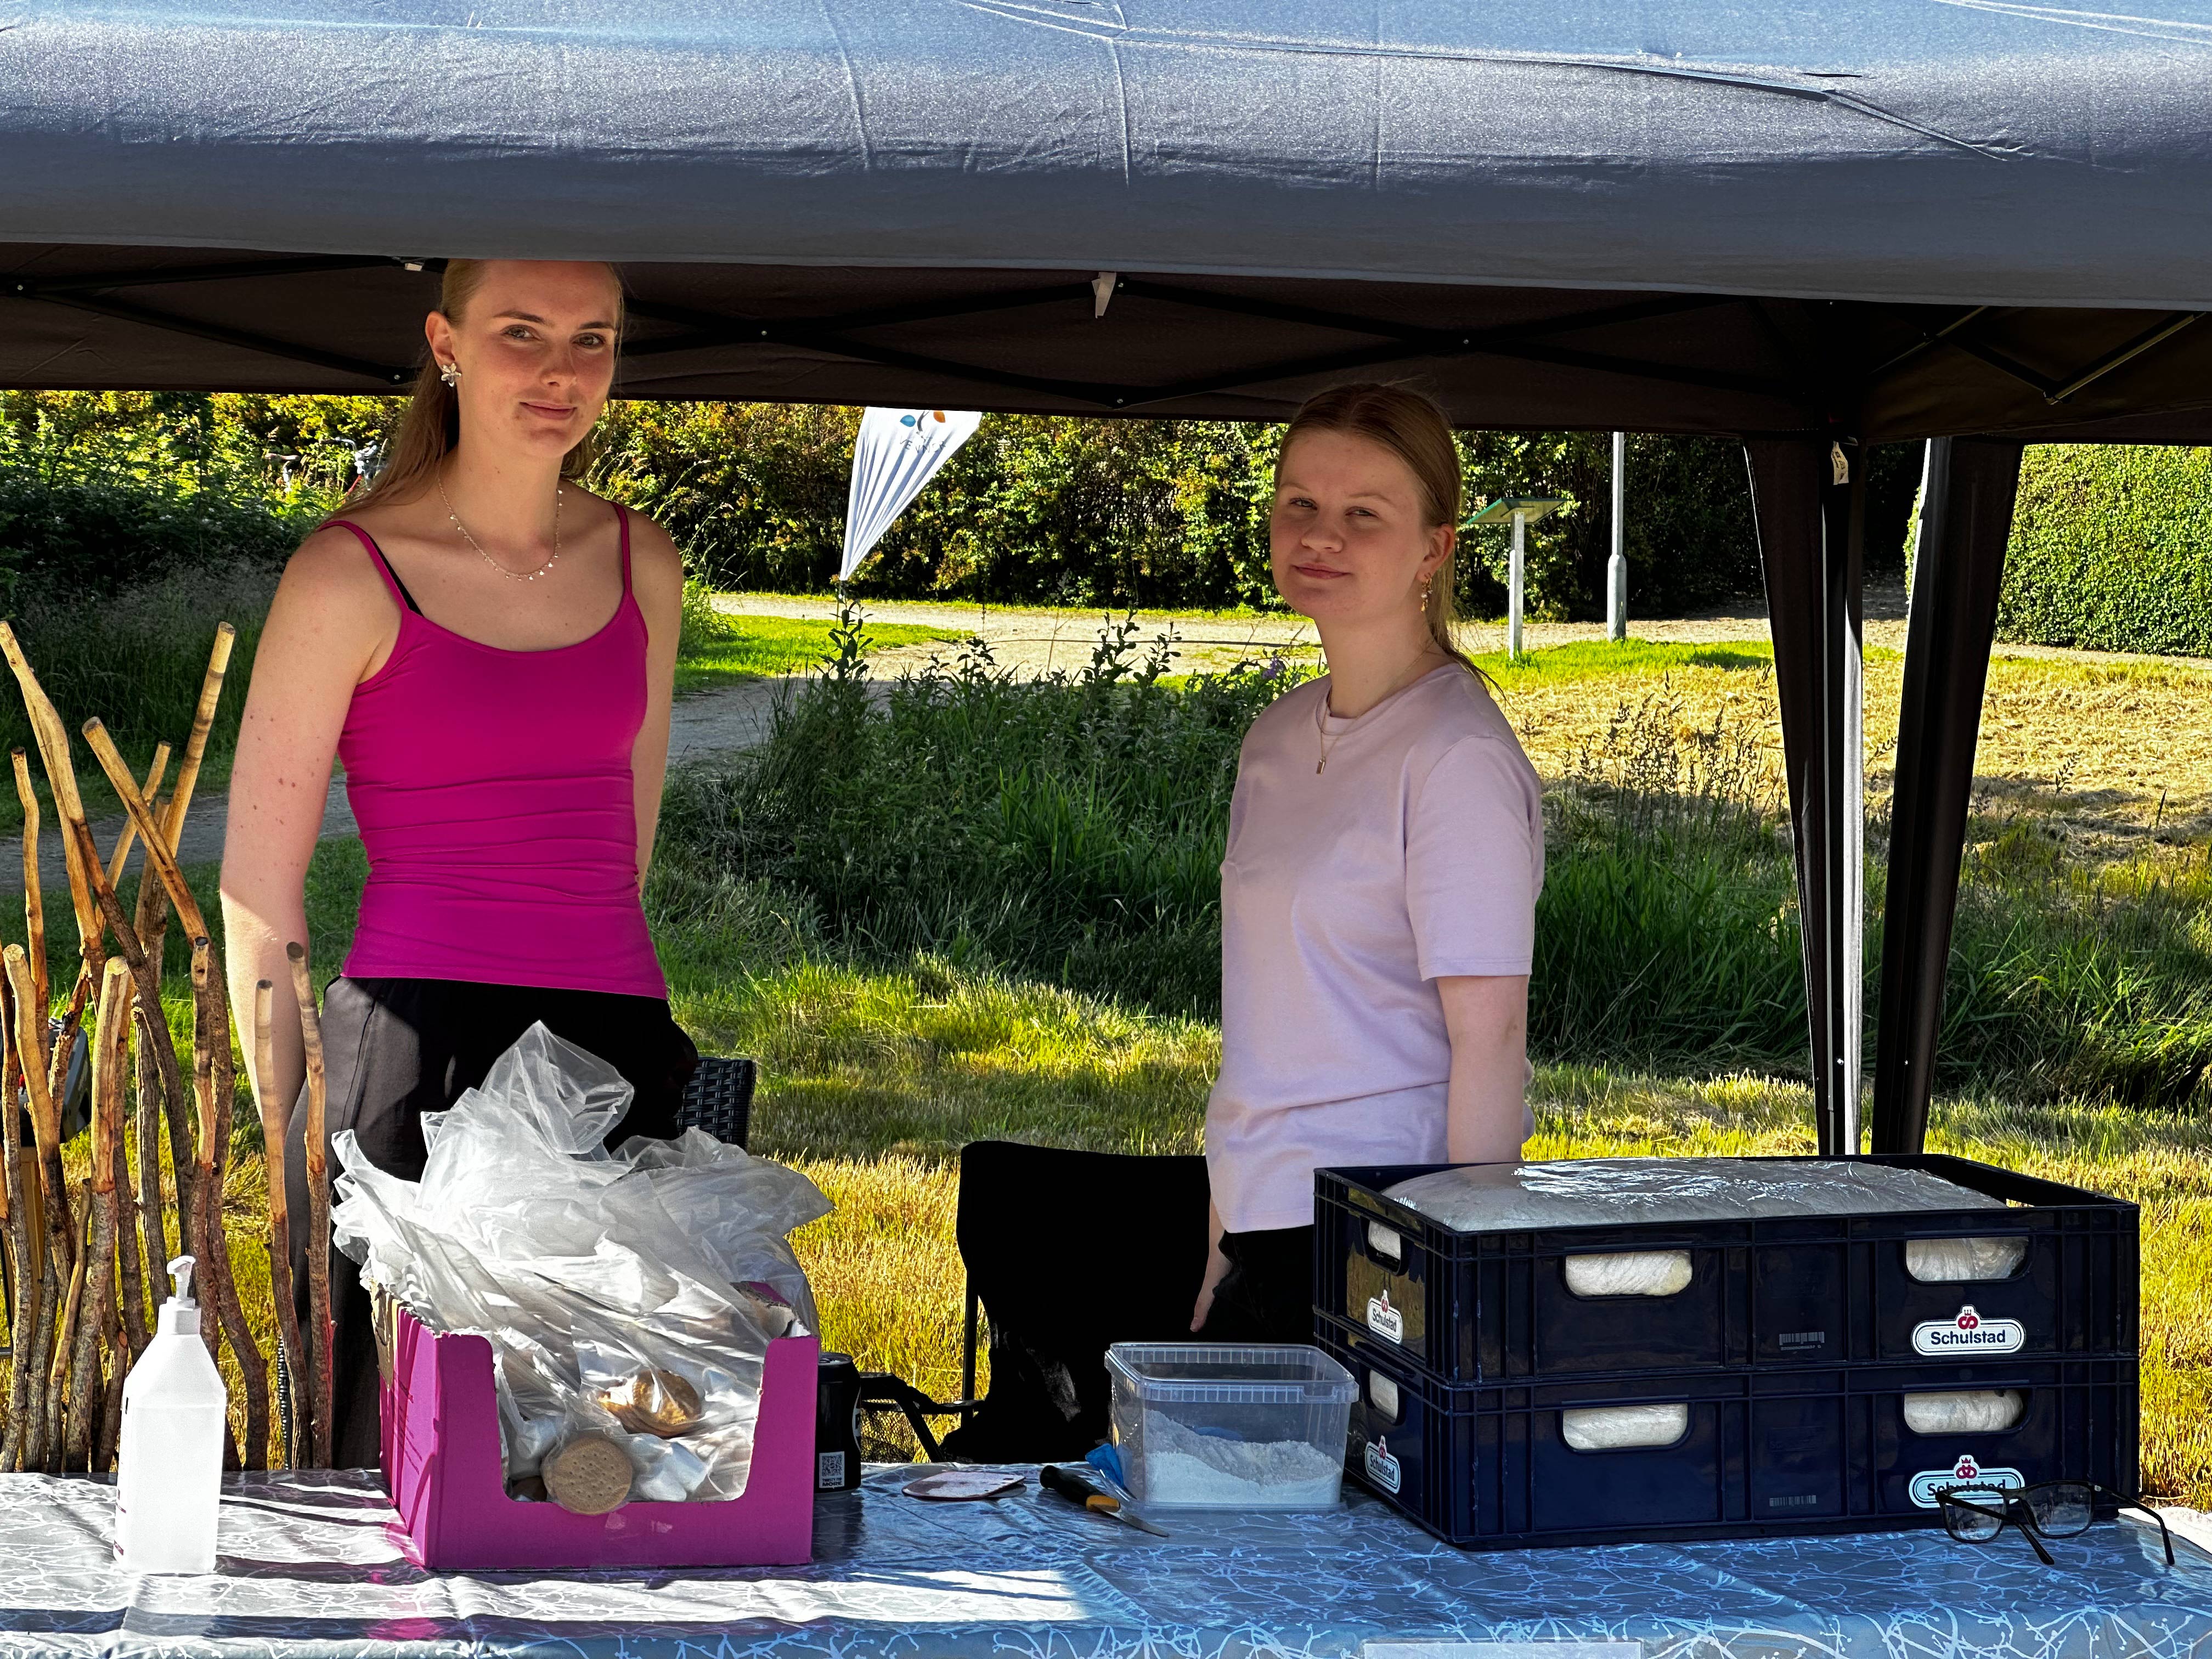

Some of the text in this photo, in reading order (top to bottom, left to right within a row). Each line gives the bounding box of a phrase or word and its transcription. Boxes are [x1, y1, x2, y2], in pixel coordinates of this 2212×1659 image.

[1373, 1308, 1397, 1334] Schulstad
[1931, 1329, 2006, 1345] Schulstad
[1370, 1454, 1395, 1481] Schulstad
[1927, 1479, 2006, 1496] Schlad
